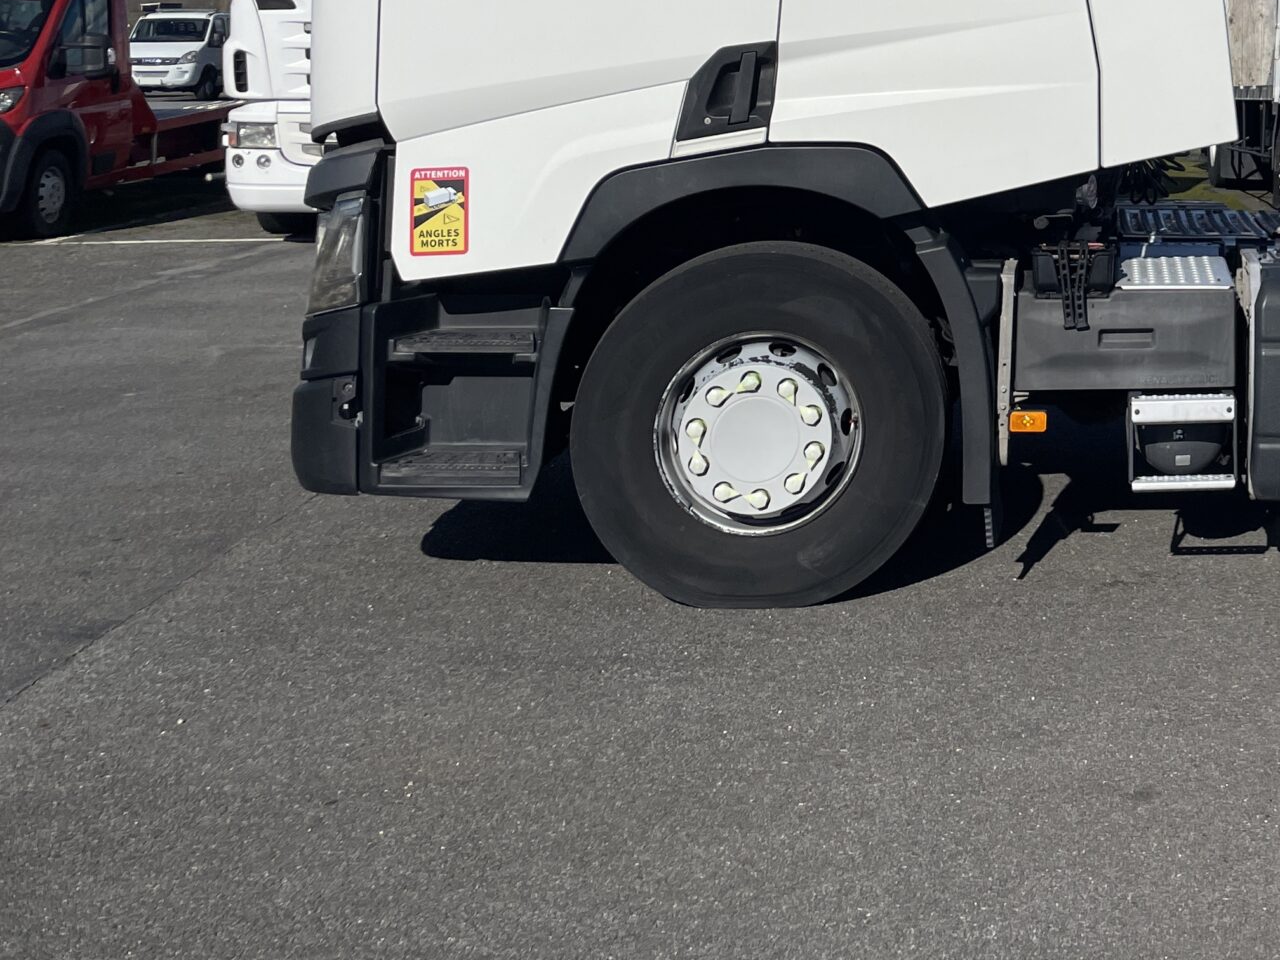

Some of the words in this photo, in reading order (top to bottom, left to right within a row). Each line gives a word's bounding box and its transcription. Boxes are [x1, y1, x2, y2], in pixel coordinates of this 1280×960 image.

[414, 169, 466, 179] ATTENTION
[418, 228, 460, 239] ANGLES
[421, 238, 458, 248] MORTS
